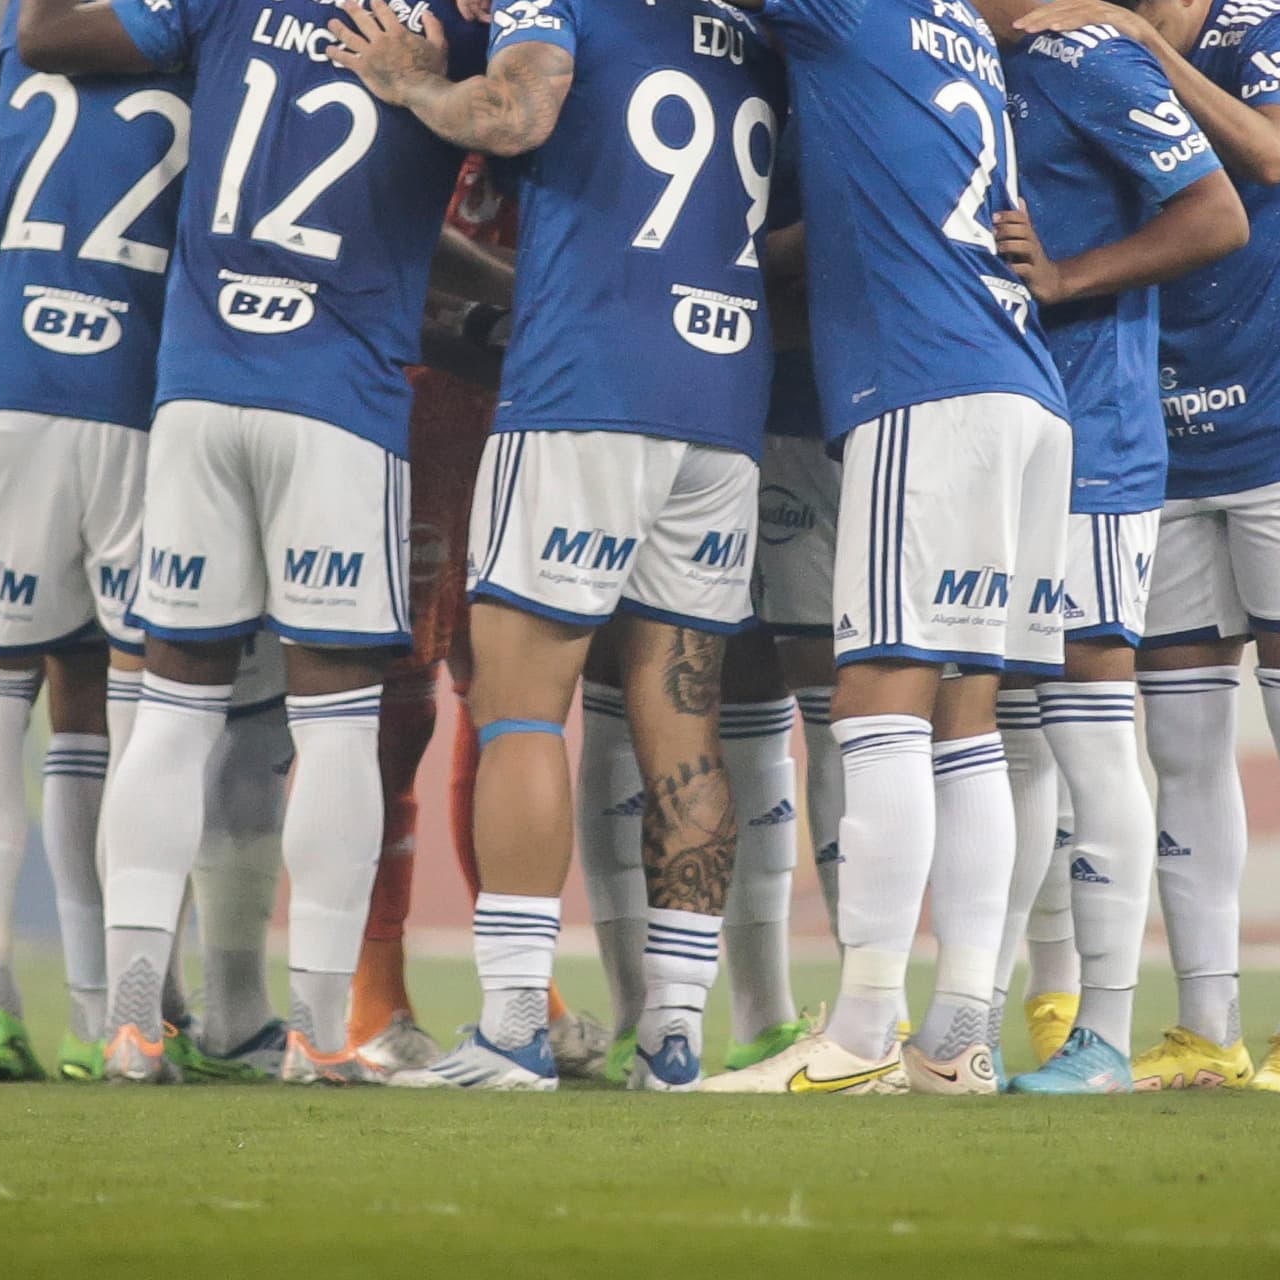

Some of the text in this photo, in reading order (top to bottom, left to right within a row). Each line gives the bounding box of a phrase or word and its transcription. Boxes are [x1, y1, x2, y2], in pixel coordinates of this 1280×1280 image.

[693, 15, 743, 64] EDU
[910, 17, 976, 72] NETO
[0, 72, 193, 273] 22
[211, 58, 379, 261] 12
[627, 68, 777, 269] 99
[932, 80, 1020, 256] 2
[33, 307, 109, 342] BH
[229, 290, 302, 322] BH
[687, 303, 739, 342] BH
